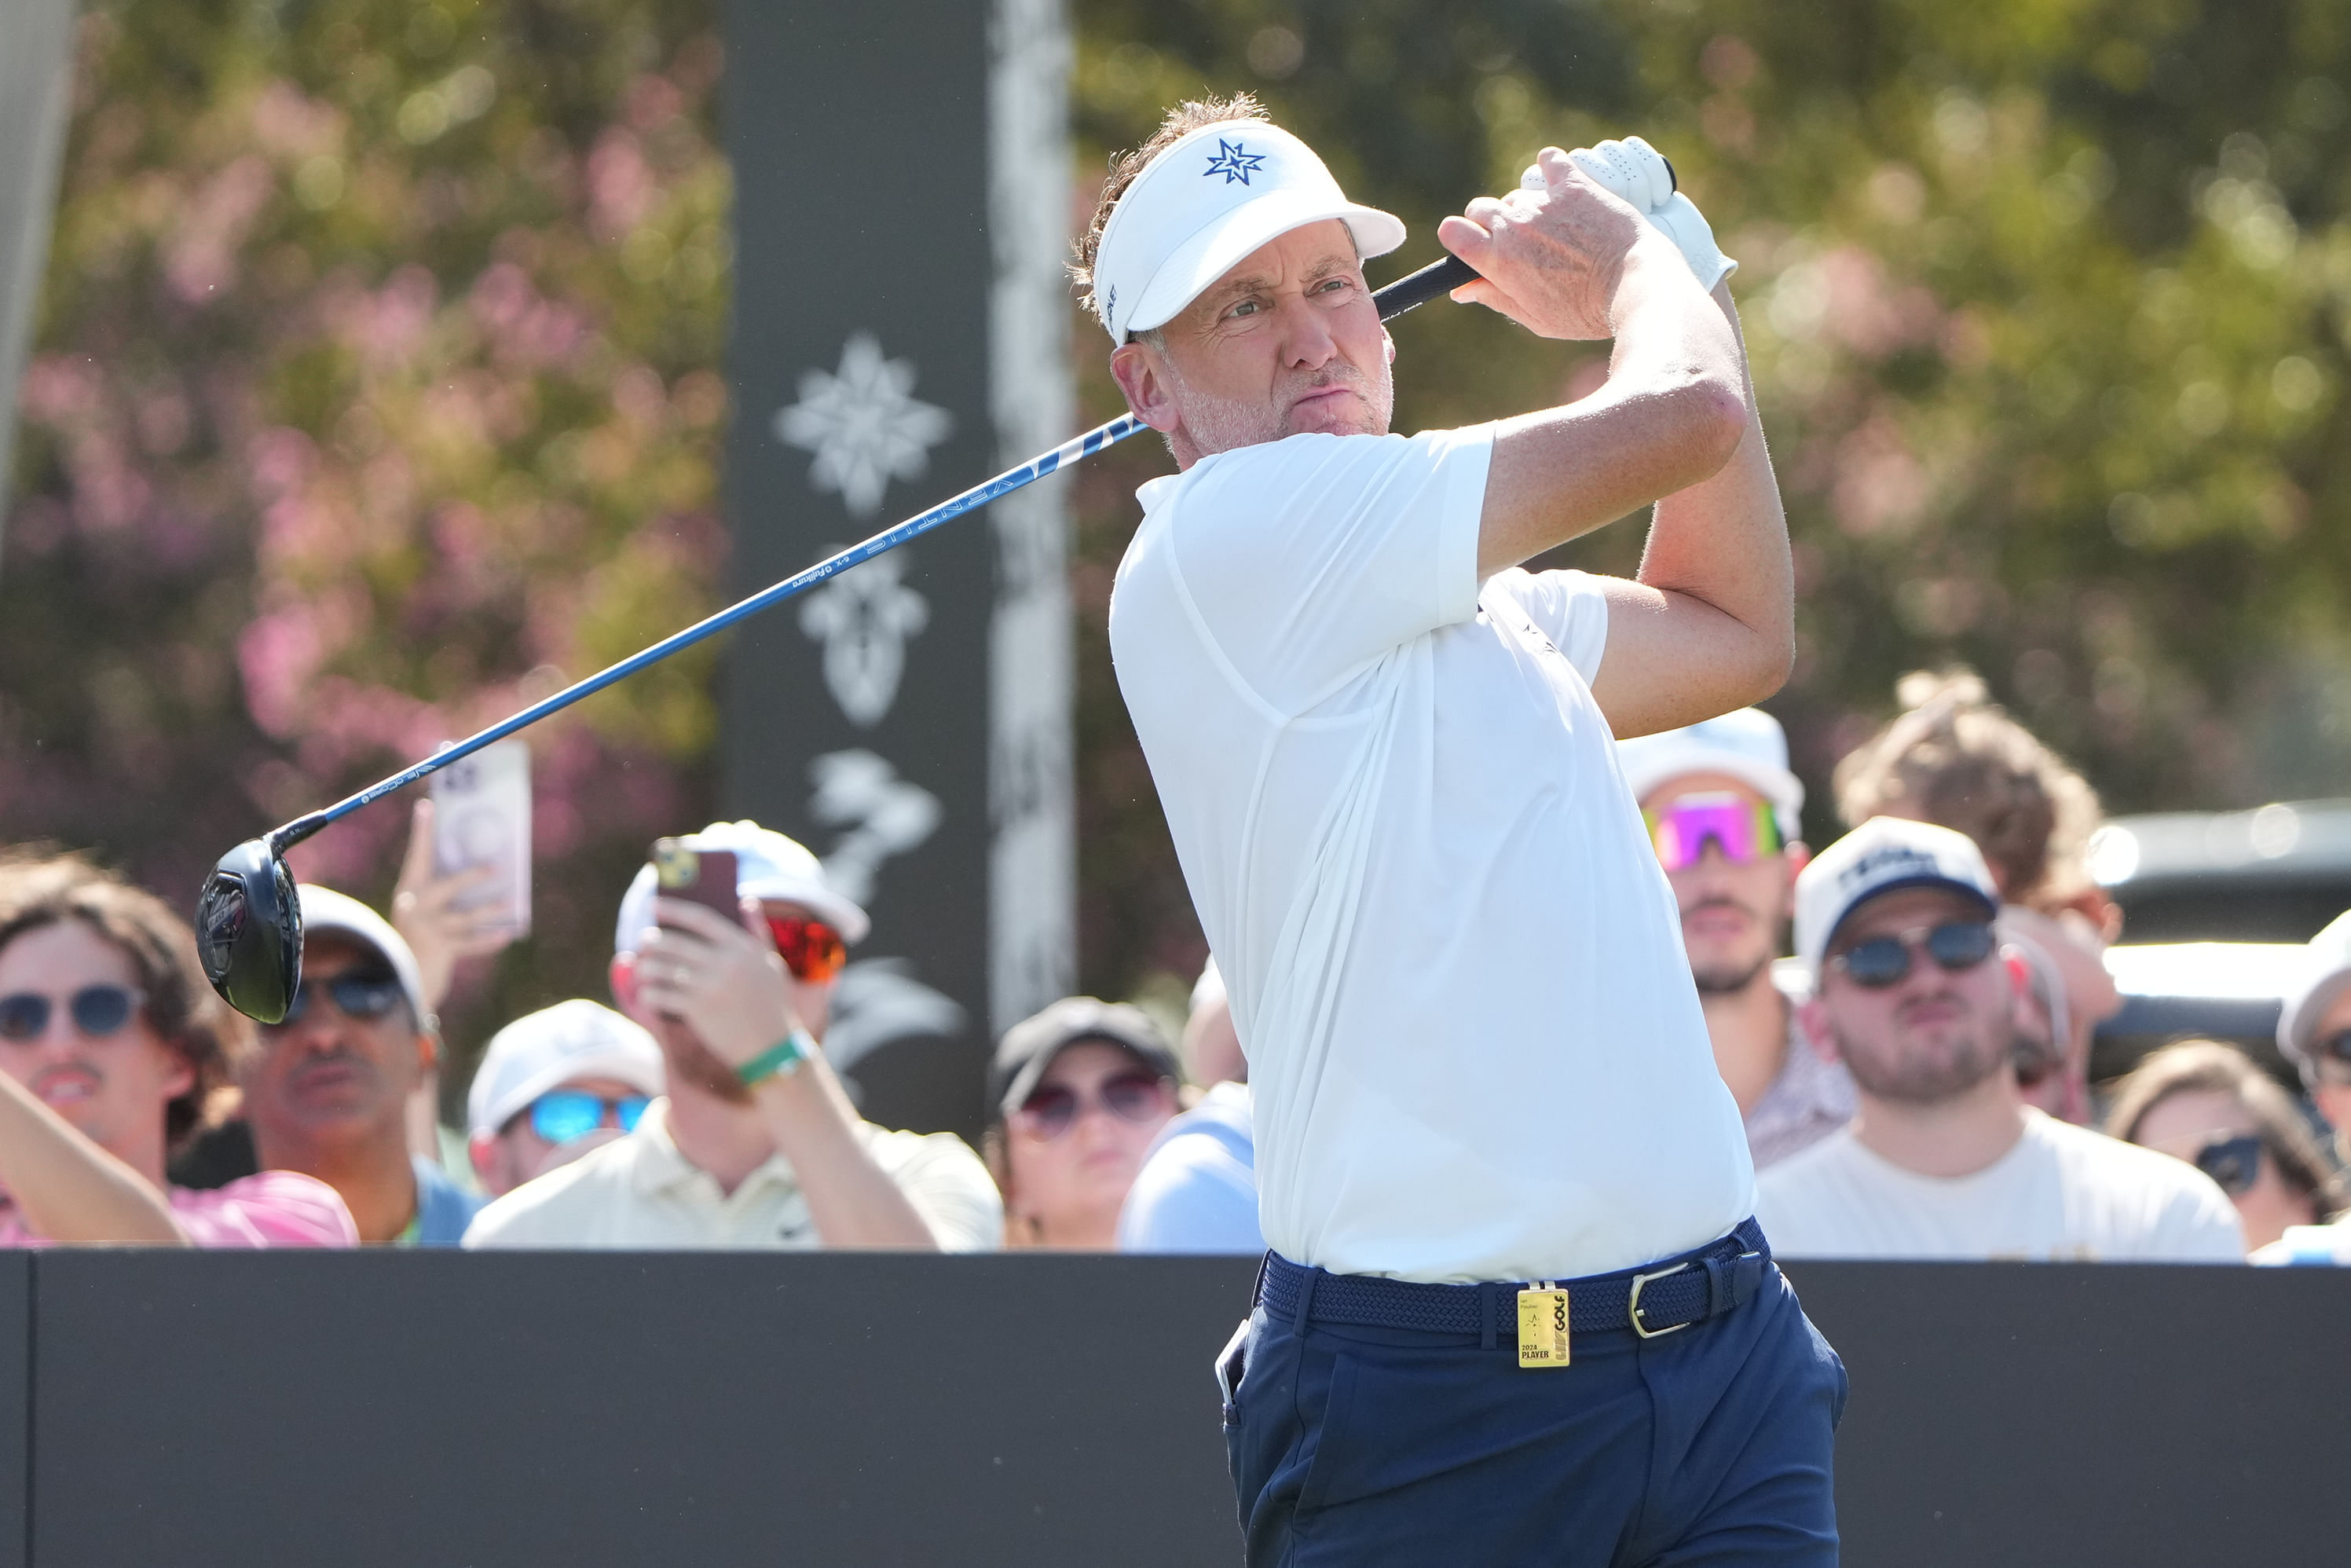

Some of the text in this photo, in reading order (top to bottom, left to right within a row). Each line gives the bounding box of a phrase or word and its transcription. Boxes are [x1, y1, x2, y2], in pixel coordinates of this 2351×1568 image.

[864, 479, 1013, 555] VENTUS
[792, 569, 826, 588] Fujikura
[1555, 1295, 1566, 1331] GOLF
